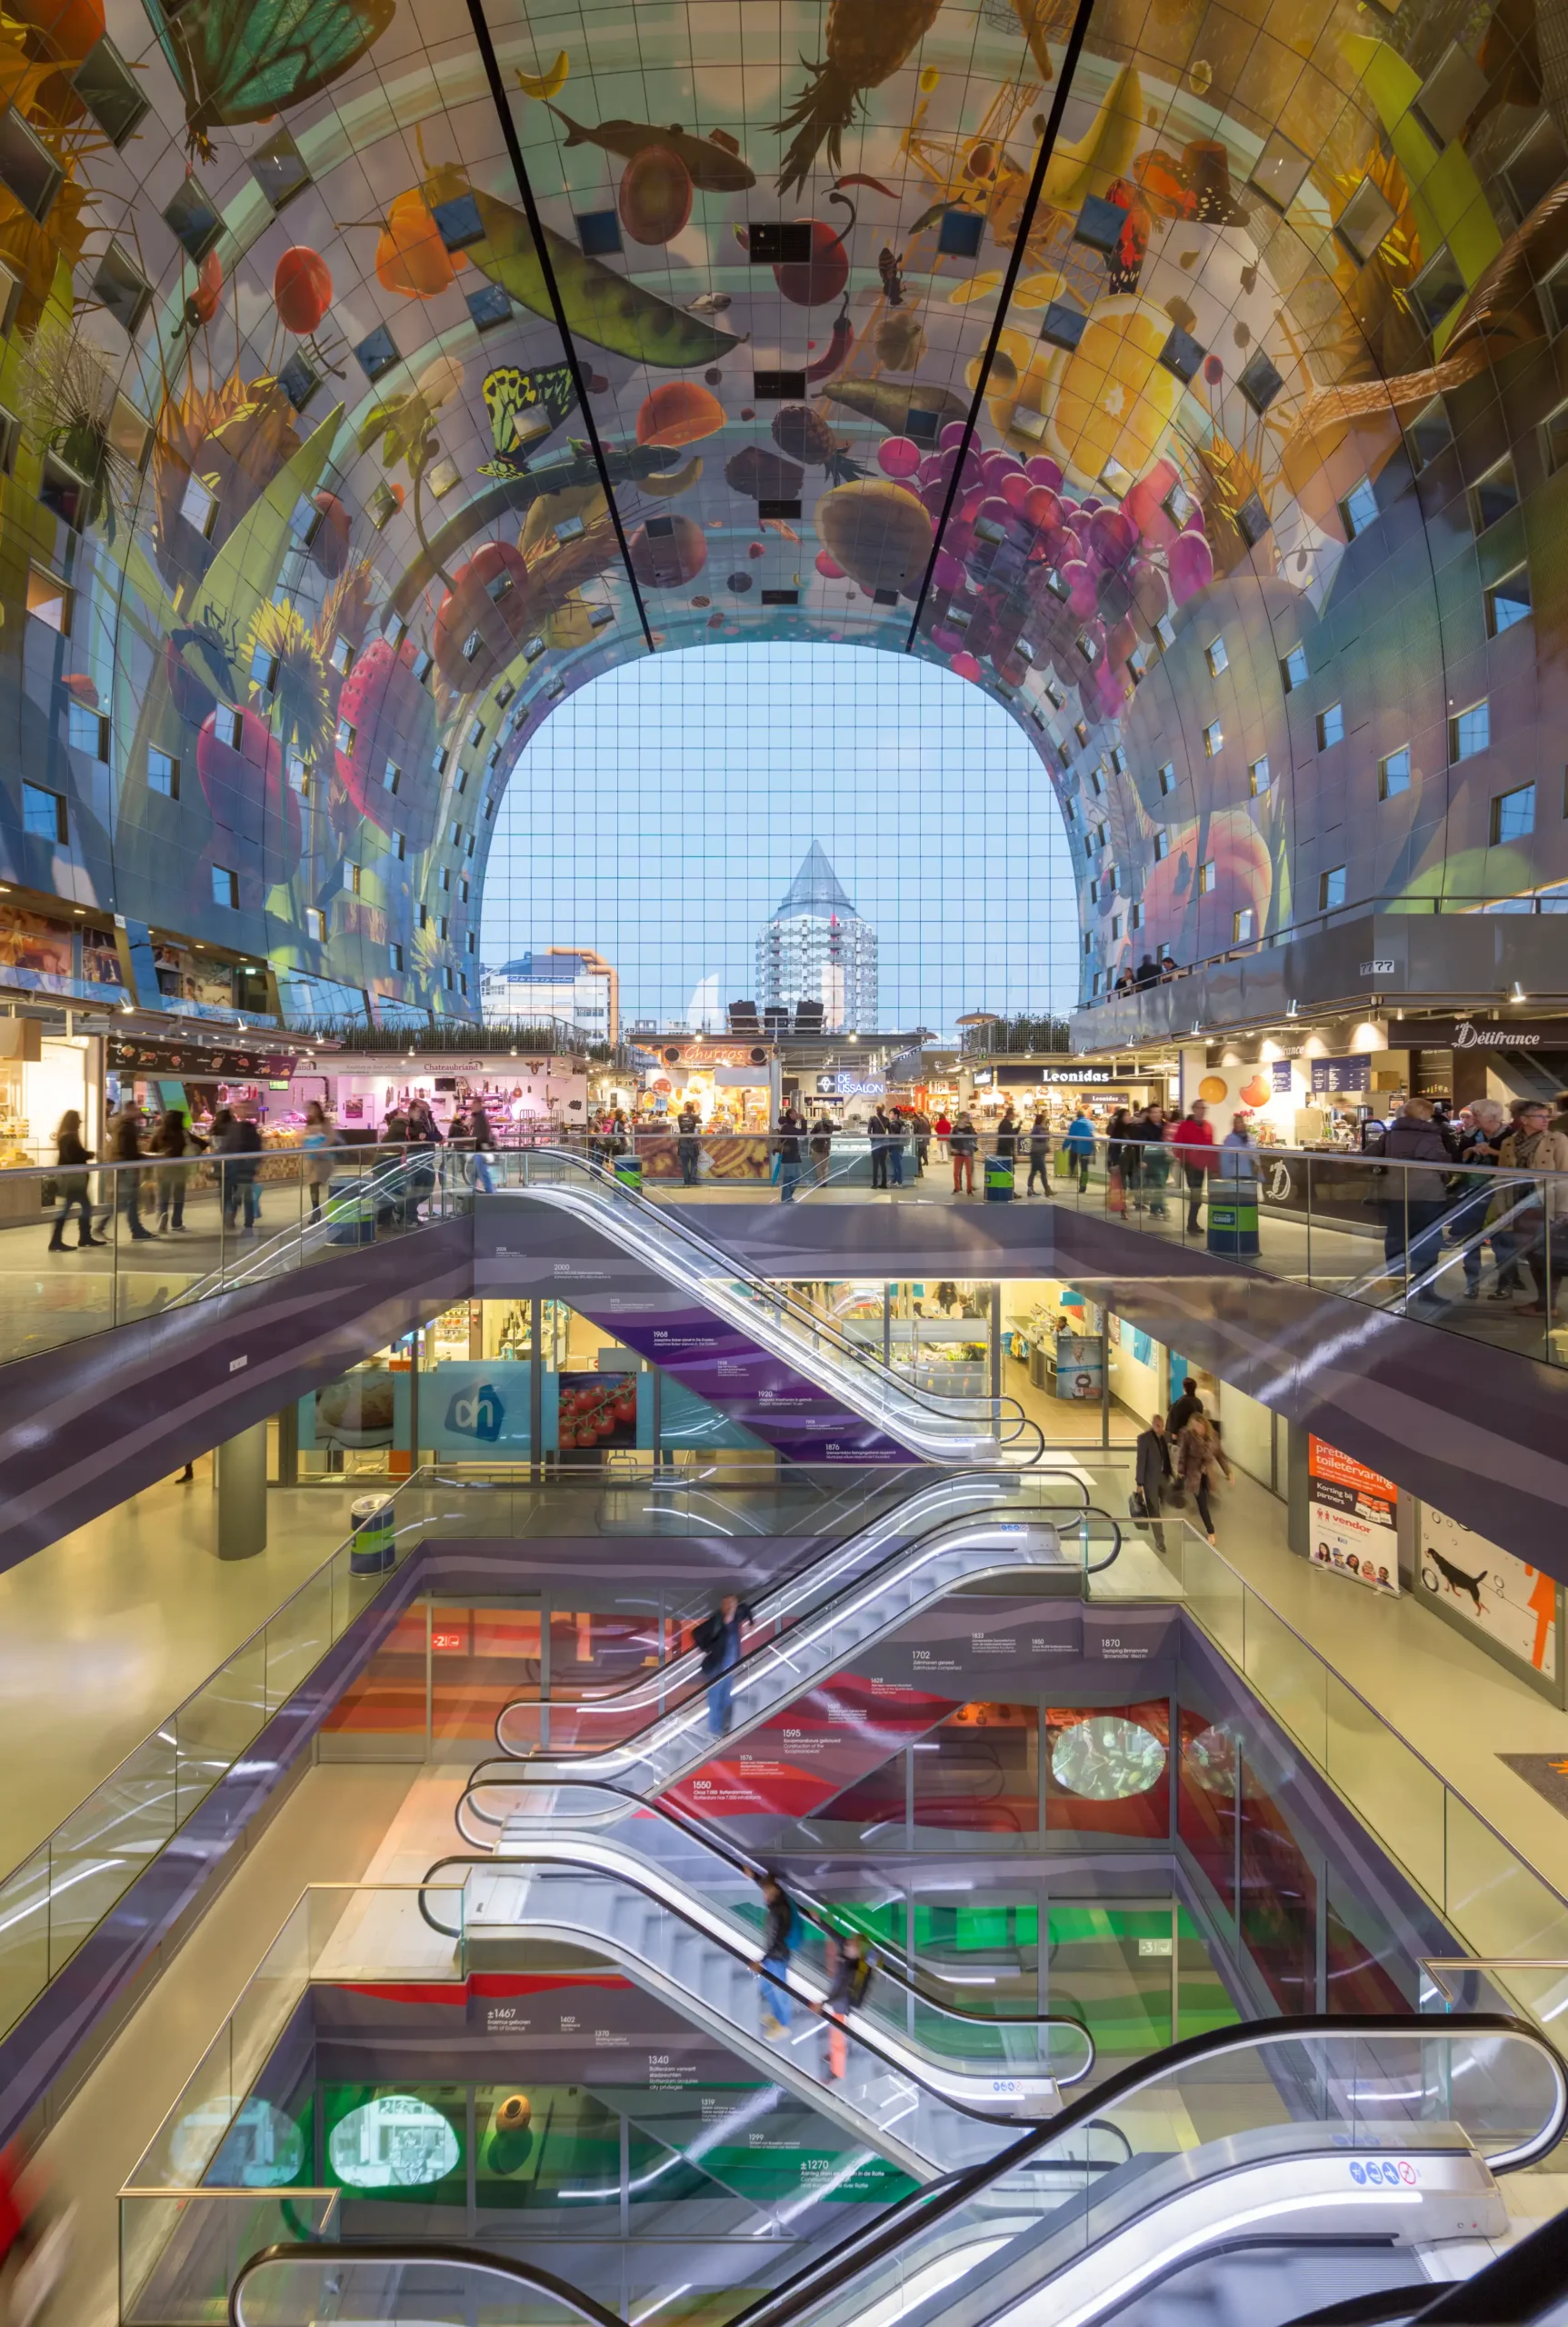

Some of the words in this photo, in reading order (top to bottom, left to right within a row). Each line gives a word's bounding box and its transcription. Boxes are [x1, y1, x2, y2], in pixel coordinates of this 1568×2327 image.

[1374, 961, 1393, 972] 77
[1451, 1021, 1540, 1048] Délifrance
[684, 1045, 744, 1060] Churros
[424, 1063, 478, 1071] Chateaubriand
[838, 1074, 851, 1084] DE
[1043, 1069, 1109, 1082] Leonidas
[838, 1084, 884, 1094] IJSSALON
[1316, 1455, 1393, 1489] toiletervaring
[1316, 1482, 1343, 1502] Korting
[1344, 1491, 1353, 1502] bij
[1316, 1491, 1345, 1505] partners
[1332, 1514, 1372, 1533] vendor
[1102, 1639, 1120, 1647] 1870
[913, 1651, 931, 1659] 1702
[783, 1729, 801, 1737] 1595
[693, 1781, 711, 1789] 1550
[487, 2009, 516, 2018] ±1467
[648, 2055, 669, 2064] 1340
[800, 2161, 829, 2170] ±1270
